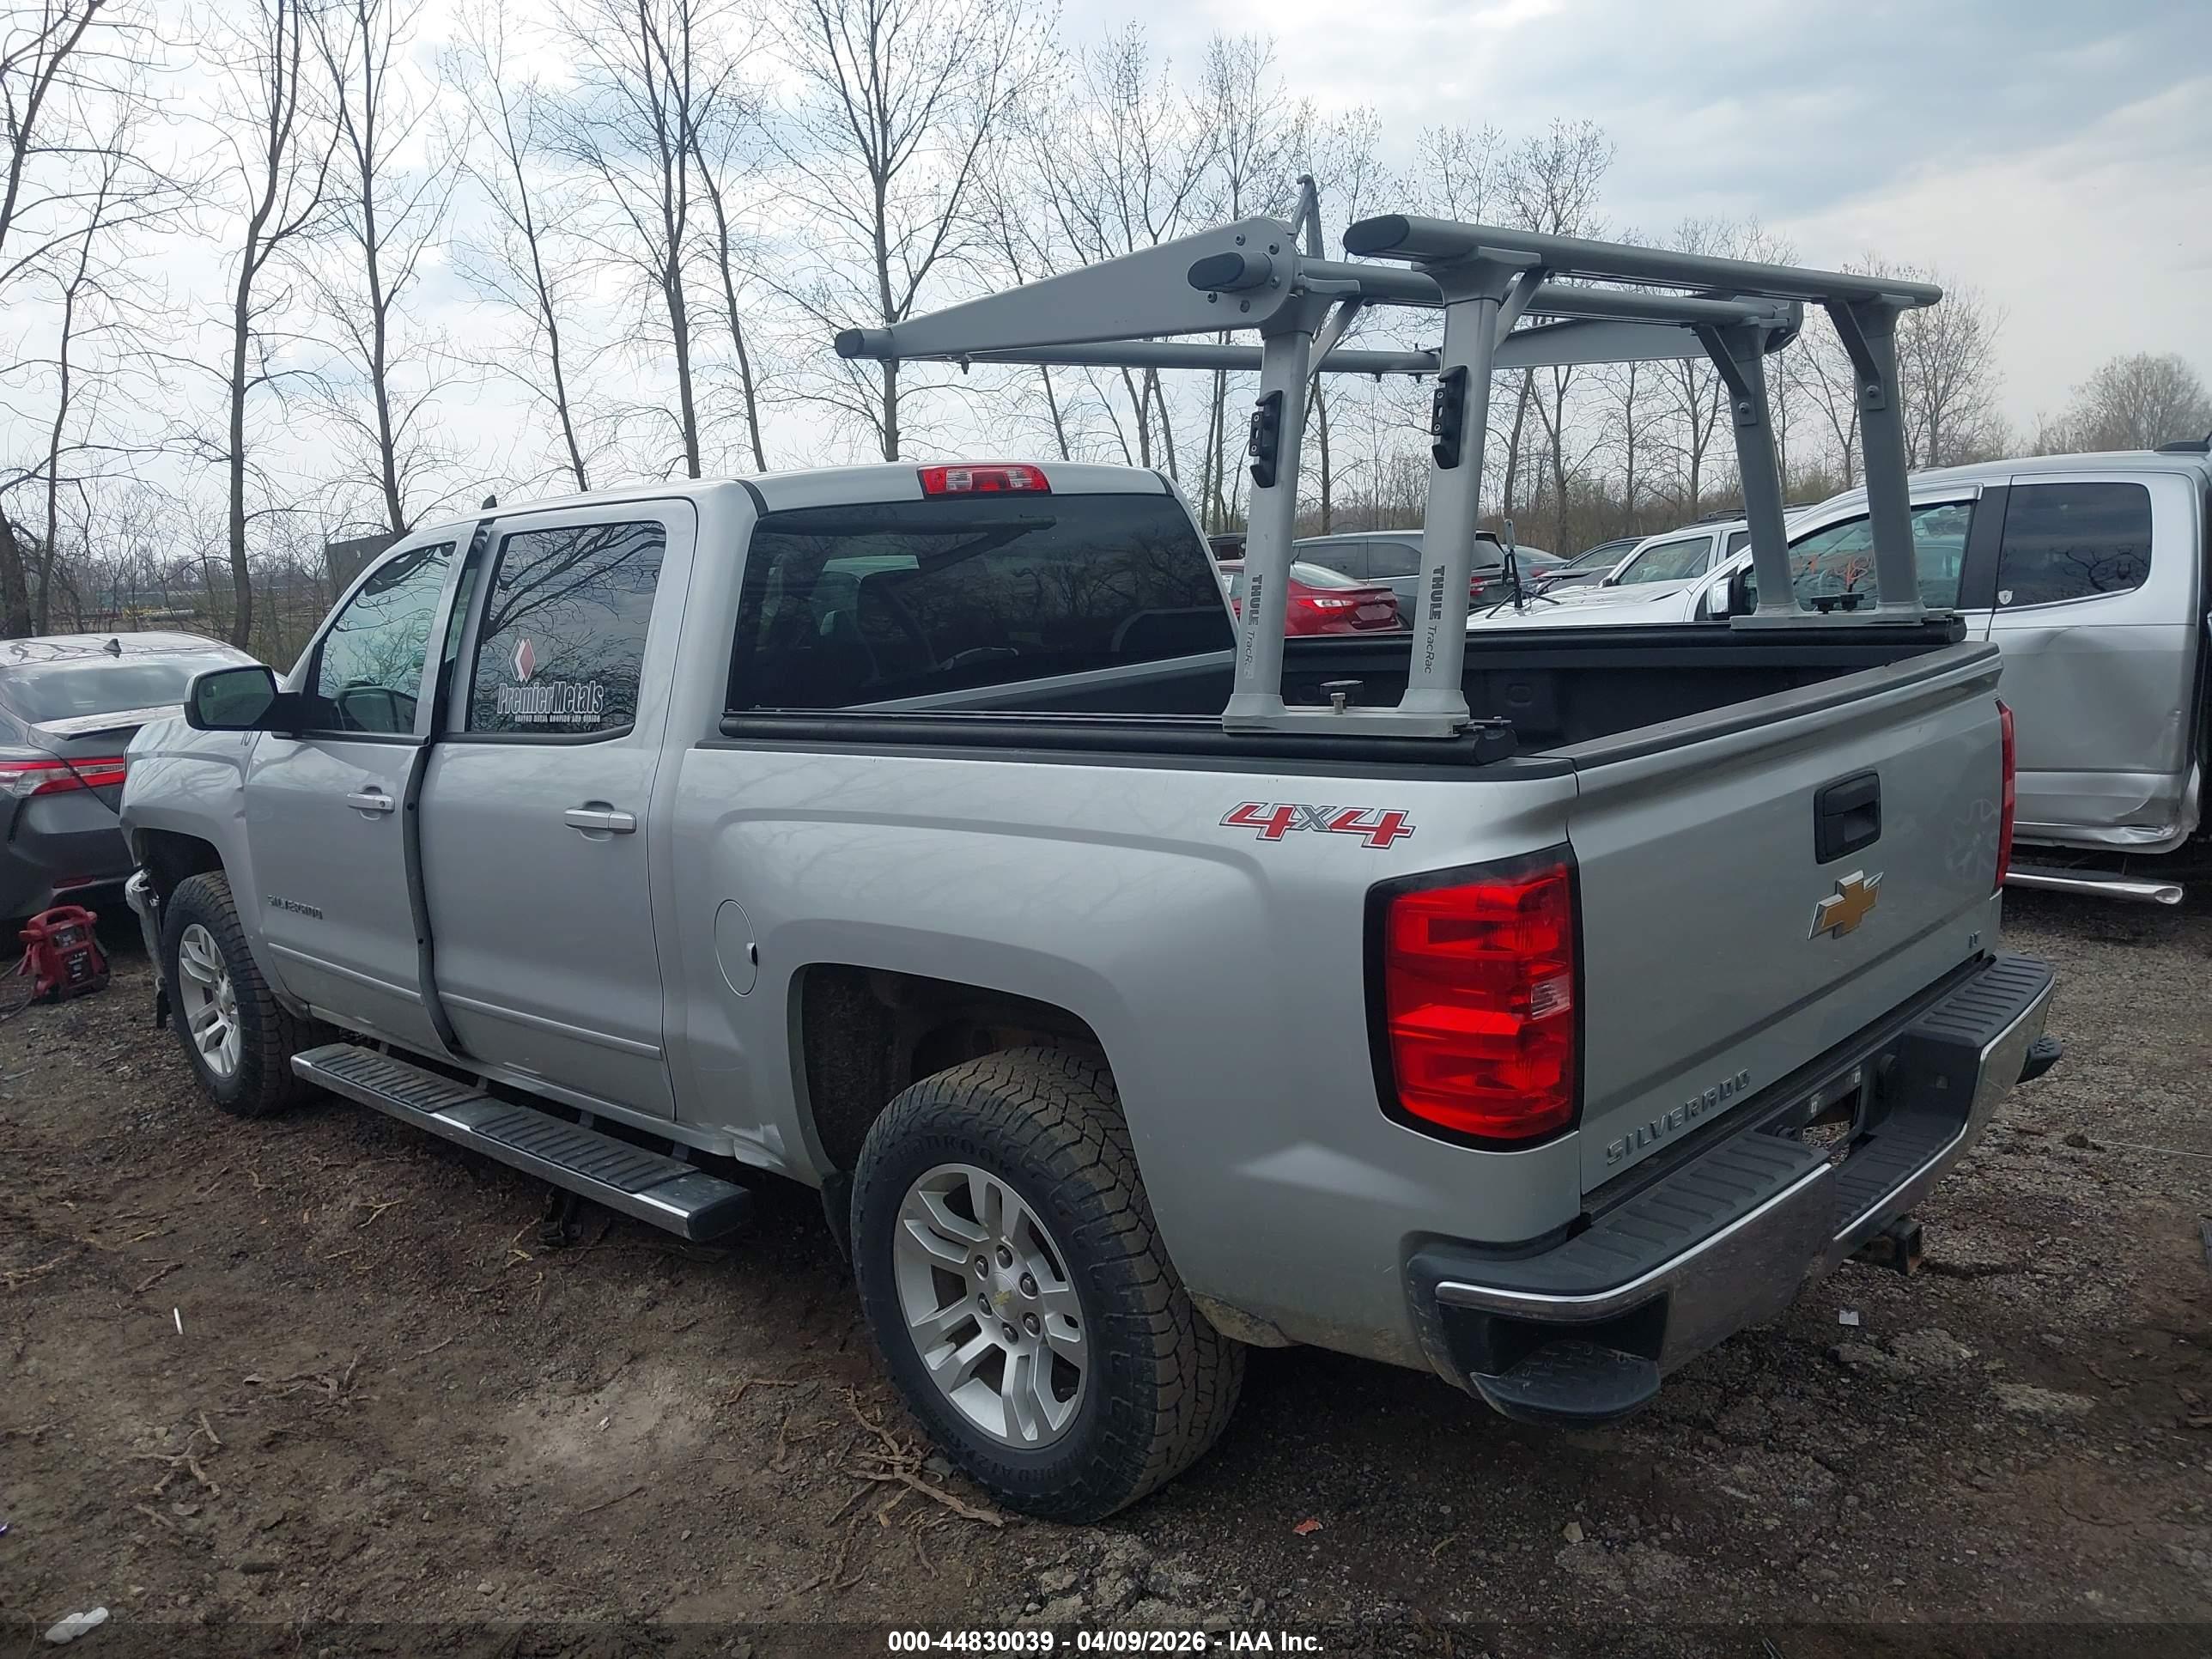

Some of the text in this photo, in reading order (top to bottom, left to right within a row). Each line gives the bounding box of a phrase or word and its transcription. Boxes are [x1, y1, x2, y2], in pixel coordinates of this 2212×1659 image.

[1248, 574, 1263, 626] THULE
[1425, 565, 1445, 674] THULE TracRac
[1606, 1068, 1751, 1166] SILVERADO
